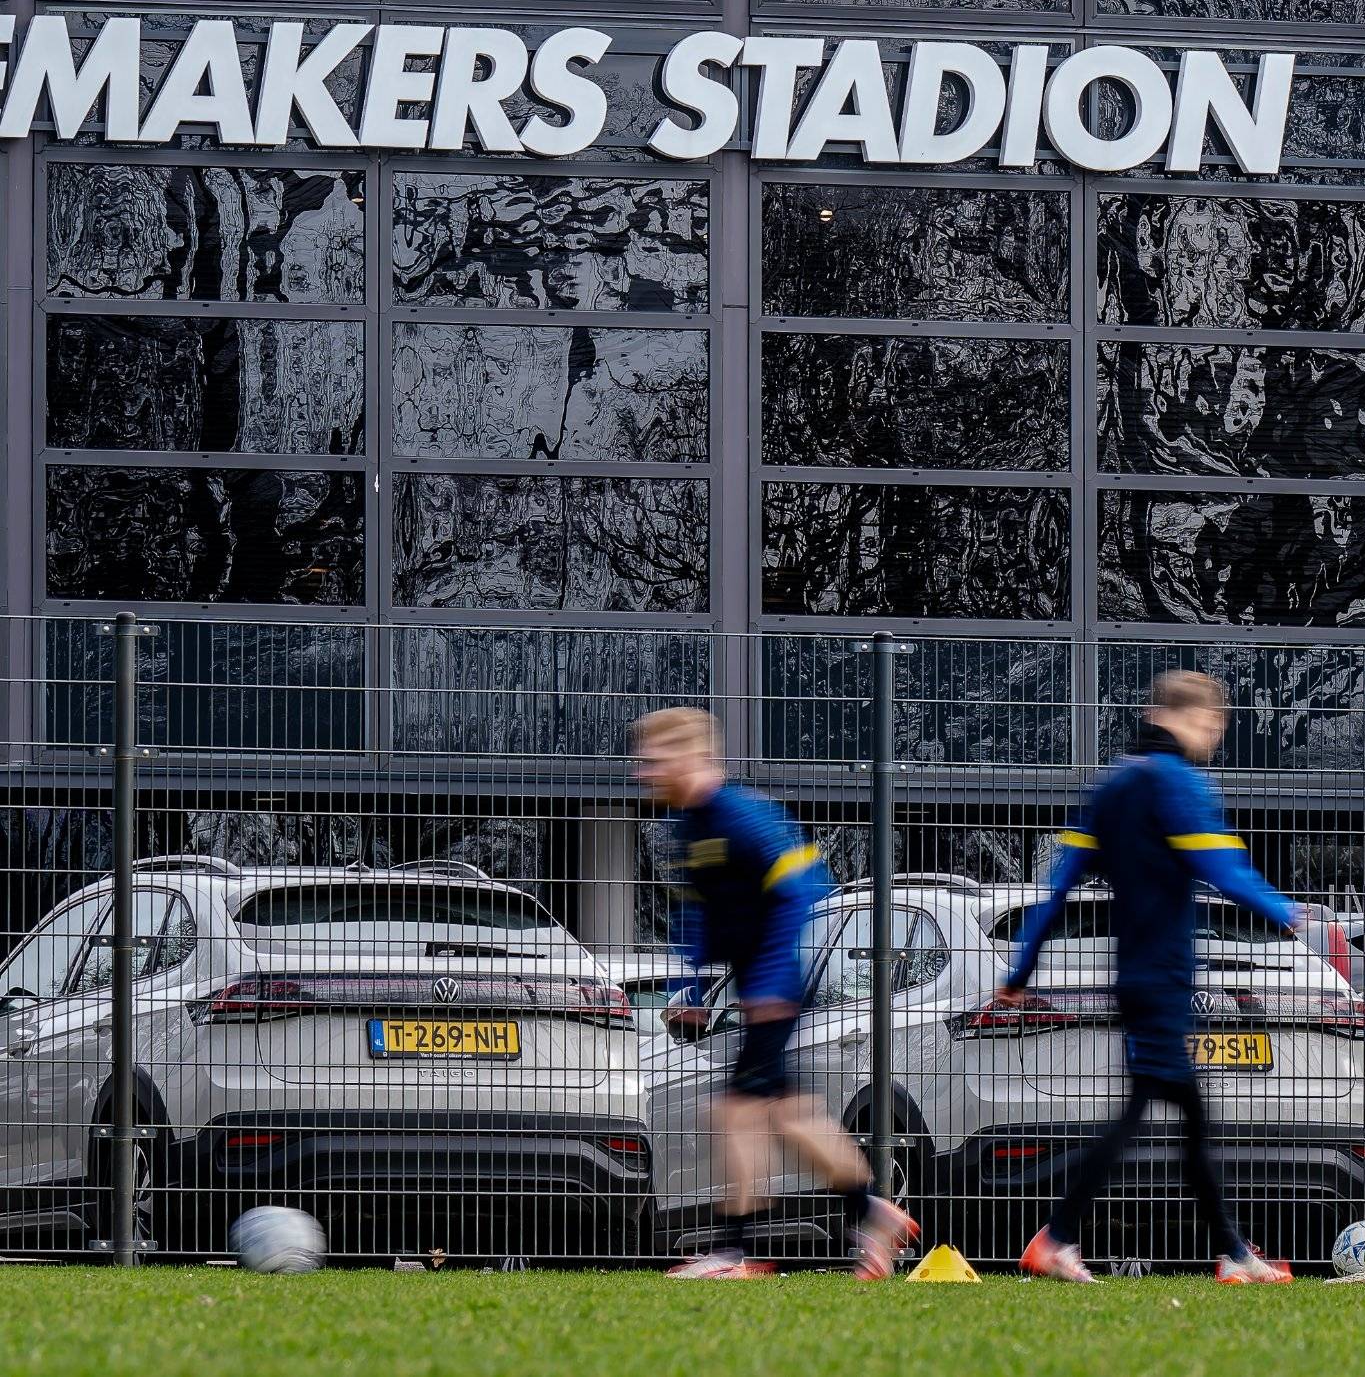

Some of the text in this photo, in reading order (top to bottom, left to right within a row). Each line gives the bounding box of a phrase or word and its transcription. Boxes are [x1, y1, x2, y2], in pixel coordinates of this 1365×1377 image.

[0, 14, 1296, 174] MAKERS STADION
[390, 1025, 508, 1049] T-269-NH
[1186, 1037, 1260, 1060] 79-SH
